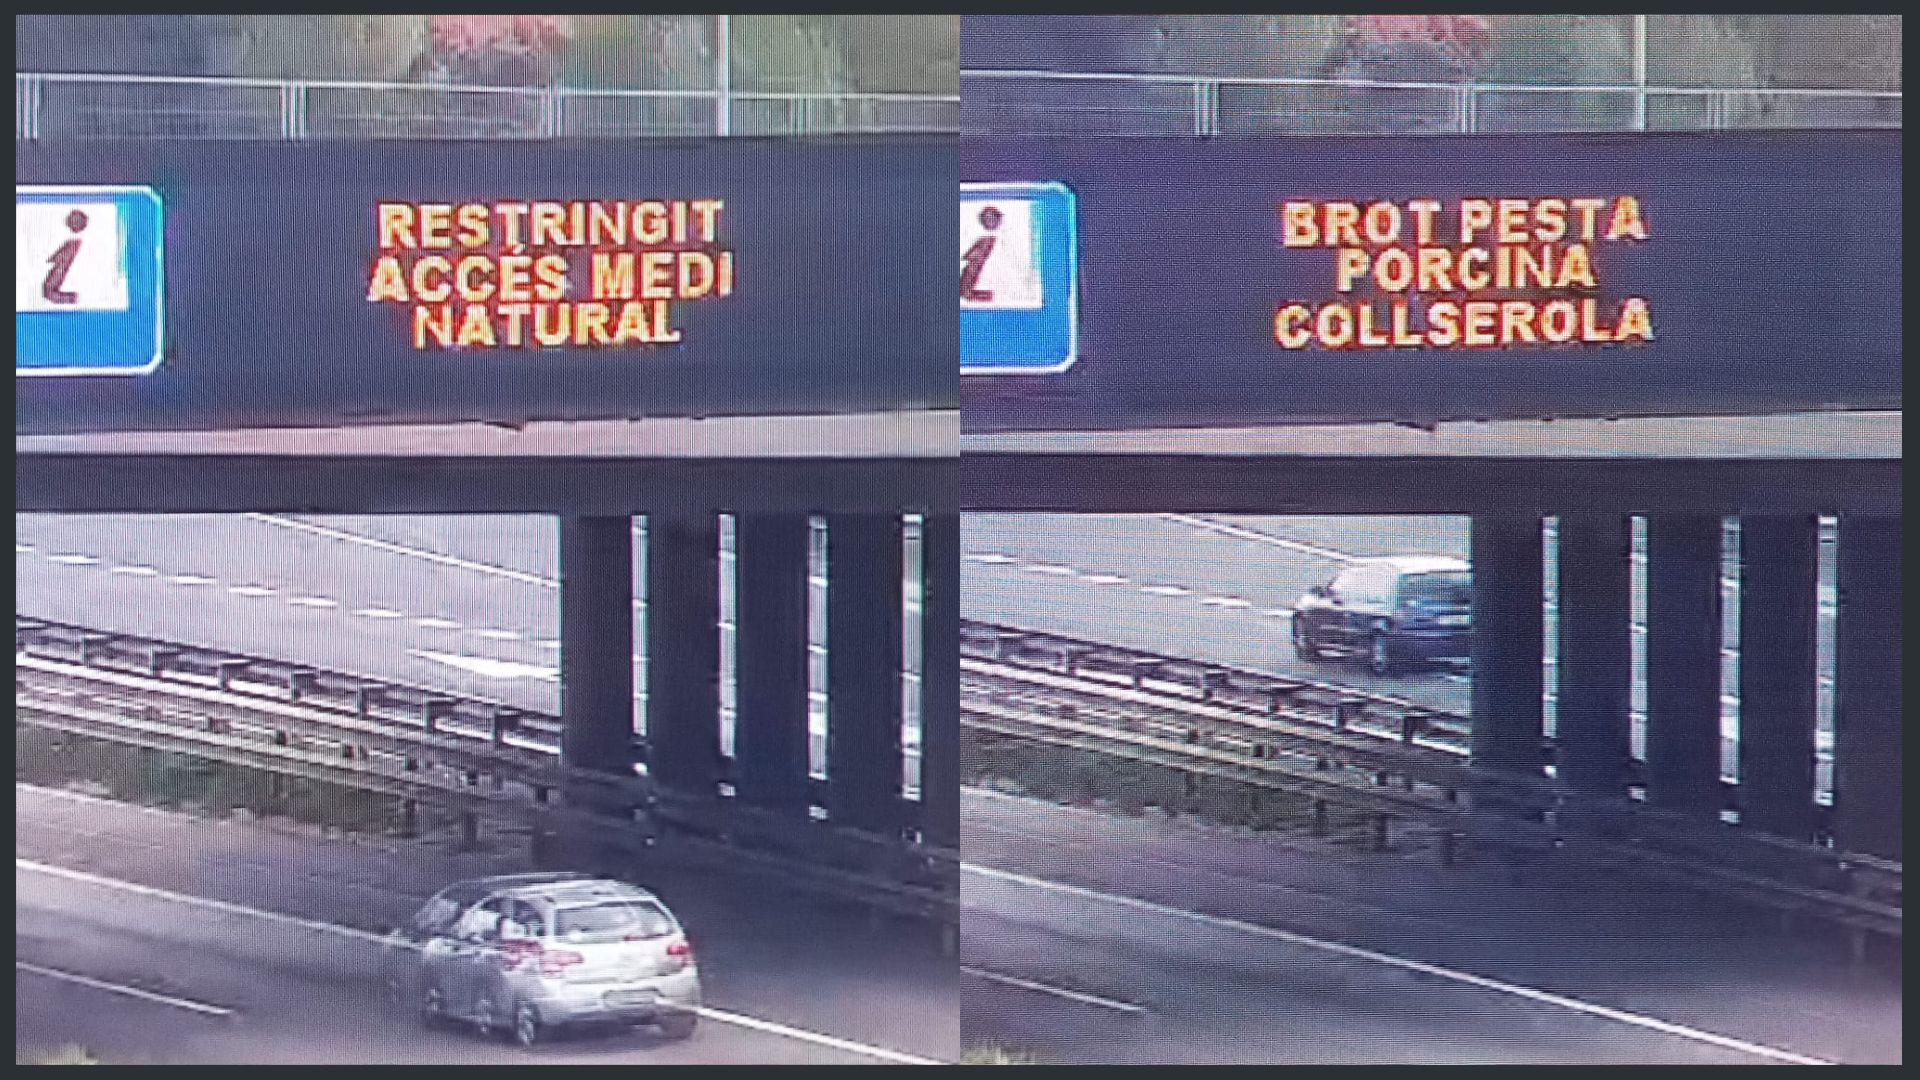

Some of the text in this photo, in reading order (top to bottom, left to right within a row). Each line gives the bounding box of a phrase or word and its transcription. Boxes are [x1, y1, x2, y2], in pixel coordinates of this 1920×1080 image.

[378, 200, 724, 250] RESTRINGIT
[1282, 194, 1650, 248] BROT PESTA
[590, 250, 733, 300] MEDI
[1335, 243, 1600, 293] PORCINA
[412, 300, 681, 350] NATURAL
[1274, 297, 1655, 350] COLLSEROLA
